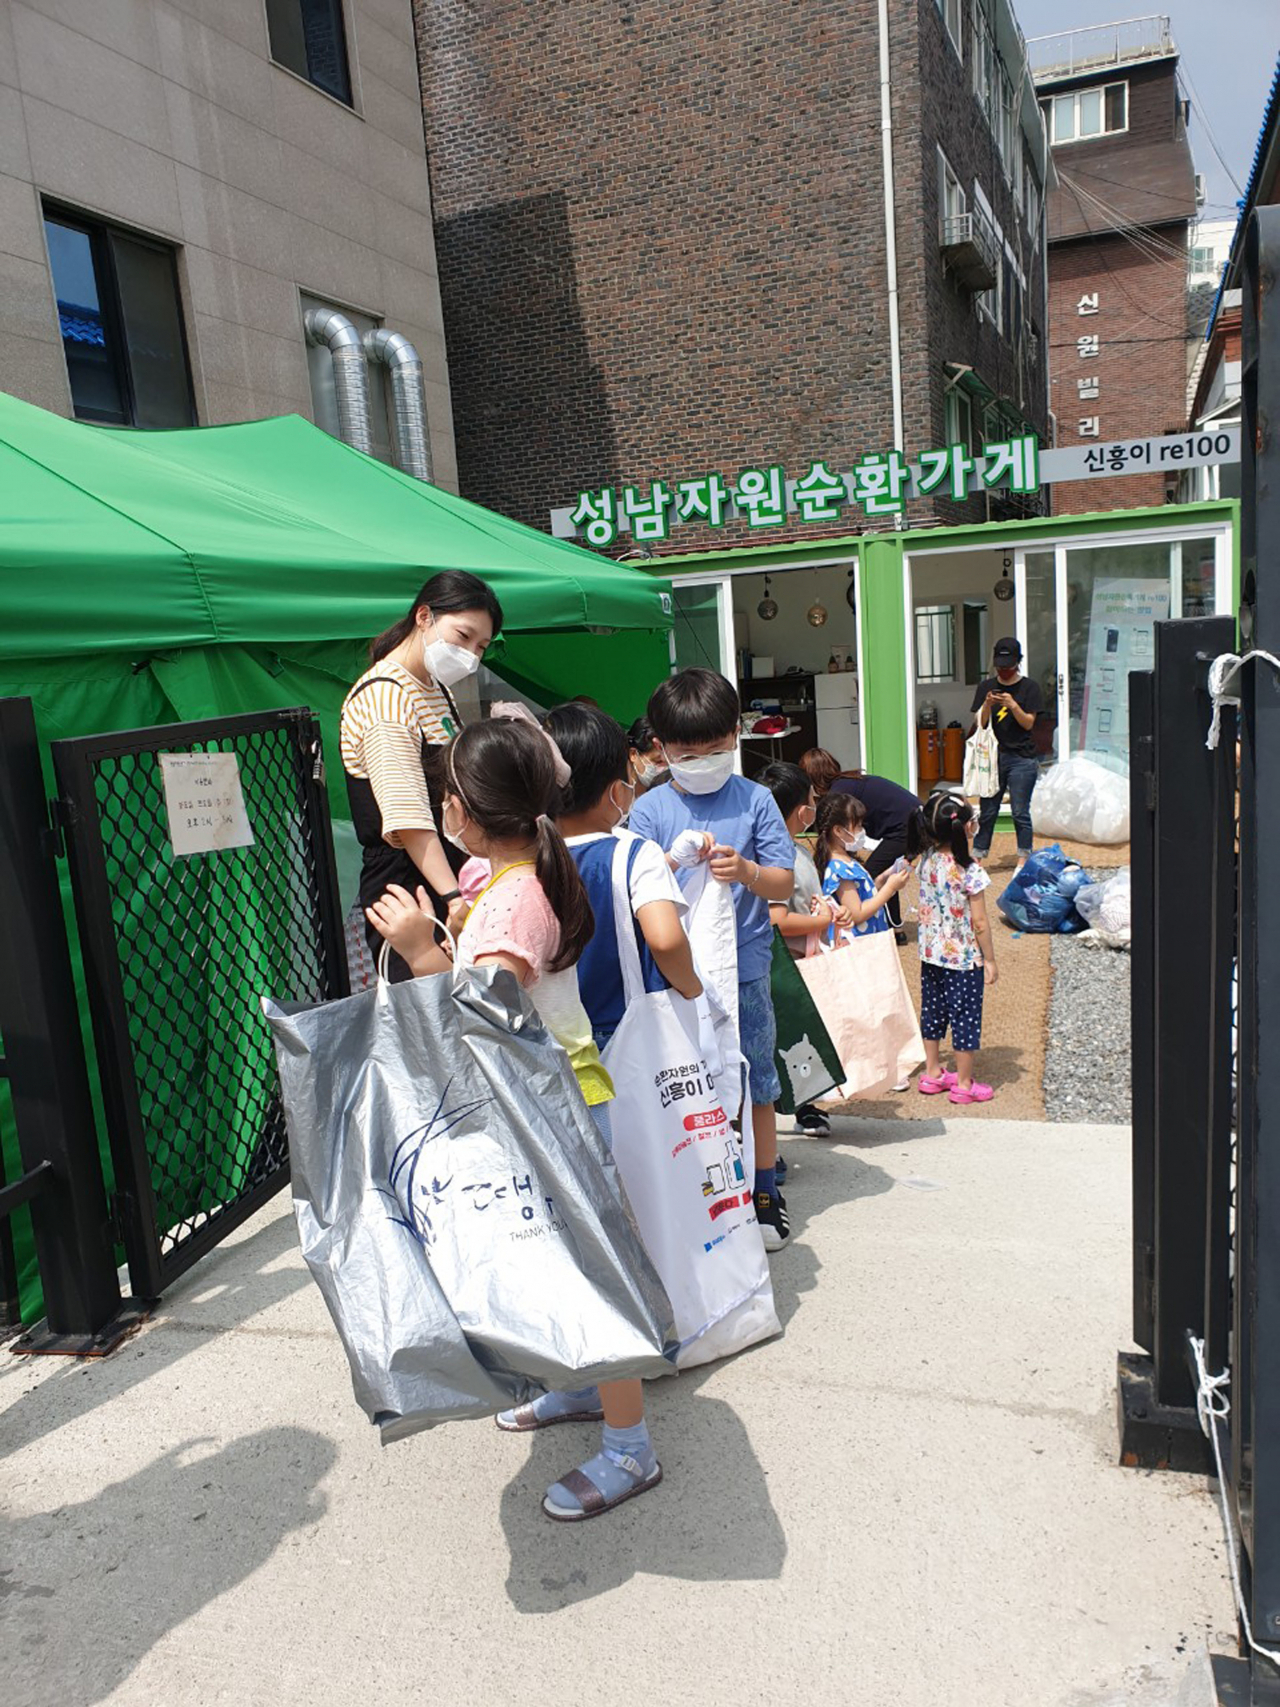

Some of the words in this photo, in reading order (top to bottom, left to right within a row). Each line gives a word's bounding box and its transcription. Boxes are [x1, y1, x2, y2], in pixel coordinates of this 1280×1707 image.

[1084, 442, 1151, 473] 신흥이
[1160, 434, 1231, 461] re100
[569, 435, 1040, 546] 성남자원순환가게
[660, 1078, 703, 1109] 신흥이
[509, 1225, 546, 1242] THANK
